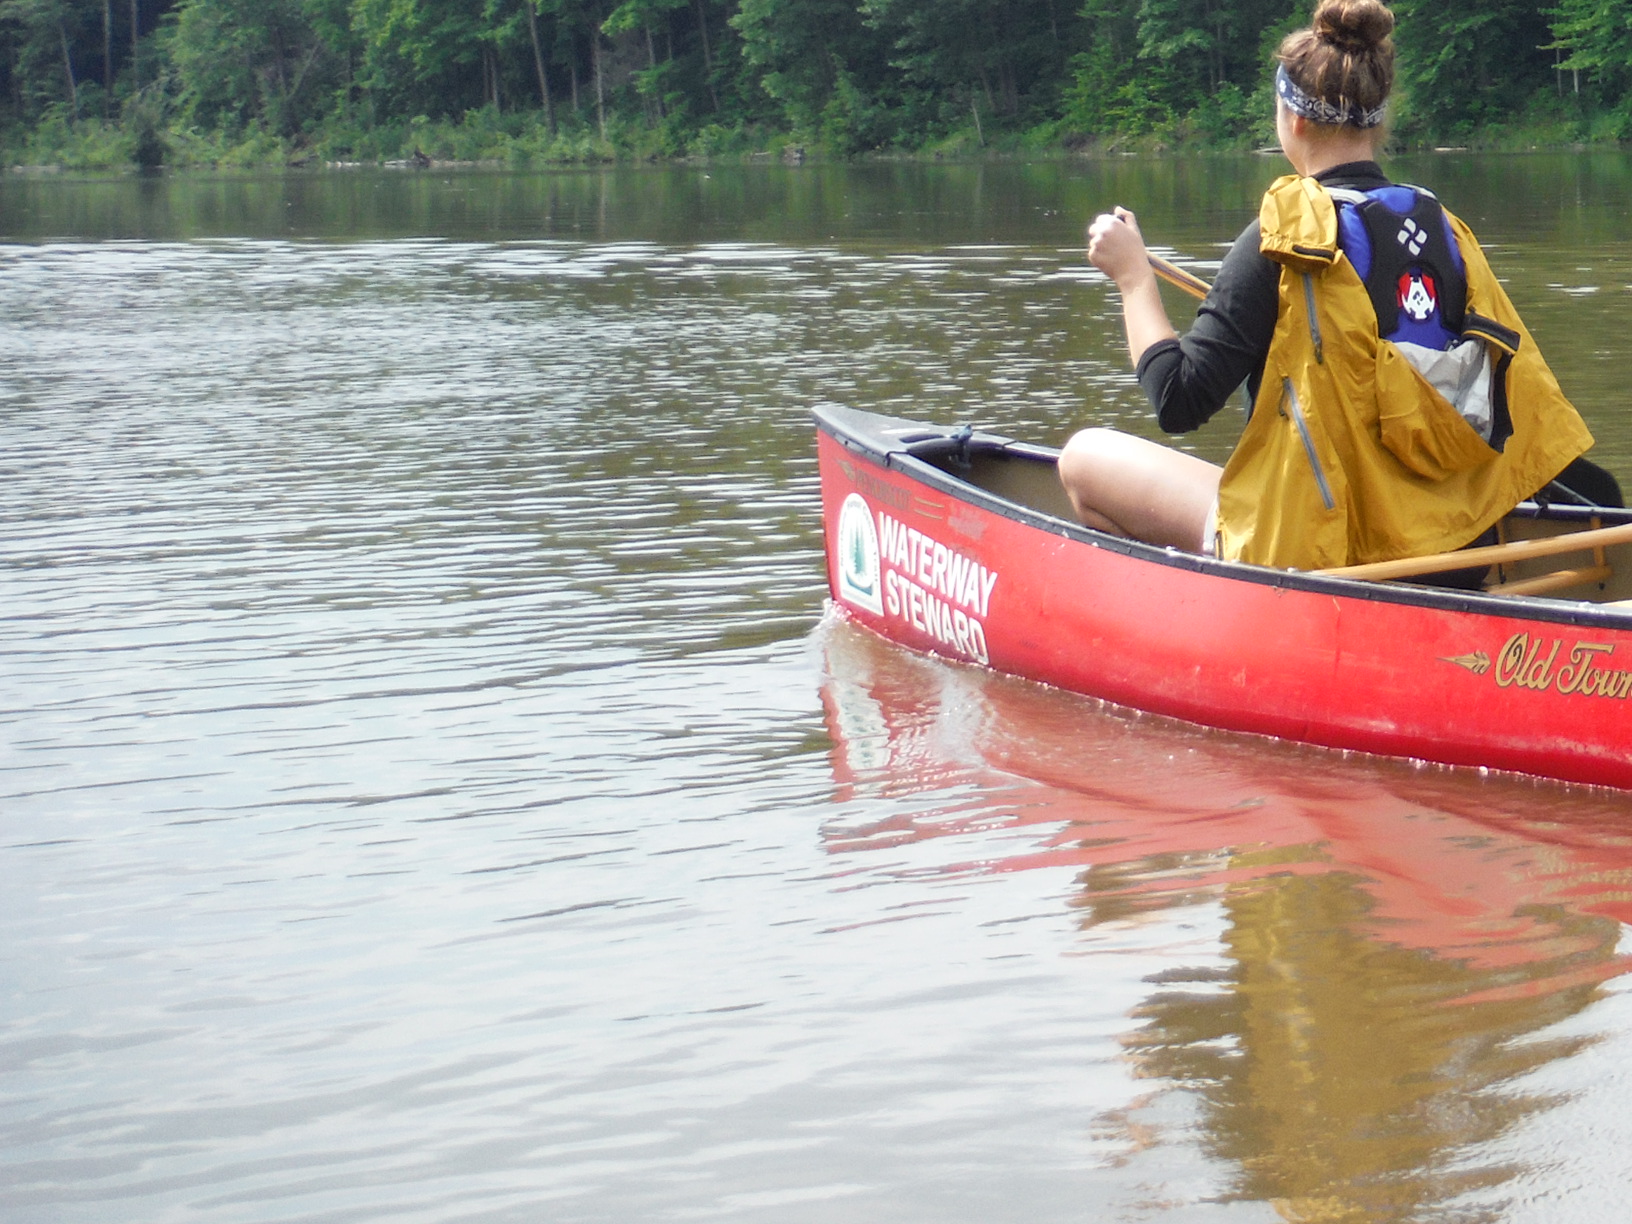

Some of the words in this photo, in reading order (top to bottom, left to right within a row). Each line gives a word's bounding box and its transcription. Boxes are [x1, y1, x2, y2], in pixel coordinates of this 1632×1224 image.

[878, 512, 997, 617] WATERWAY
[887, 569, 989, 664] STEWARD
[1495, 632, 1562, 690] Old
